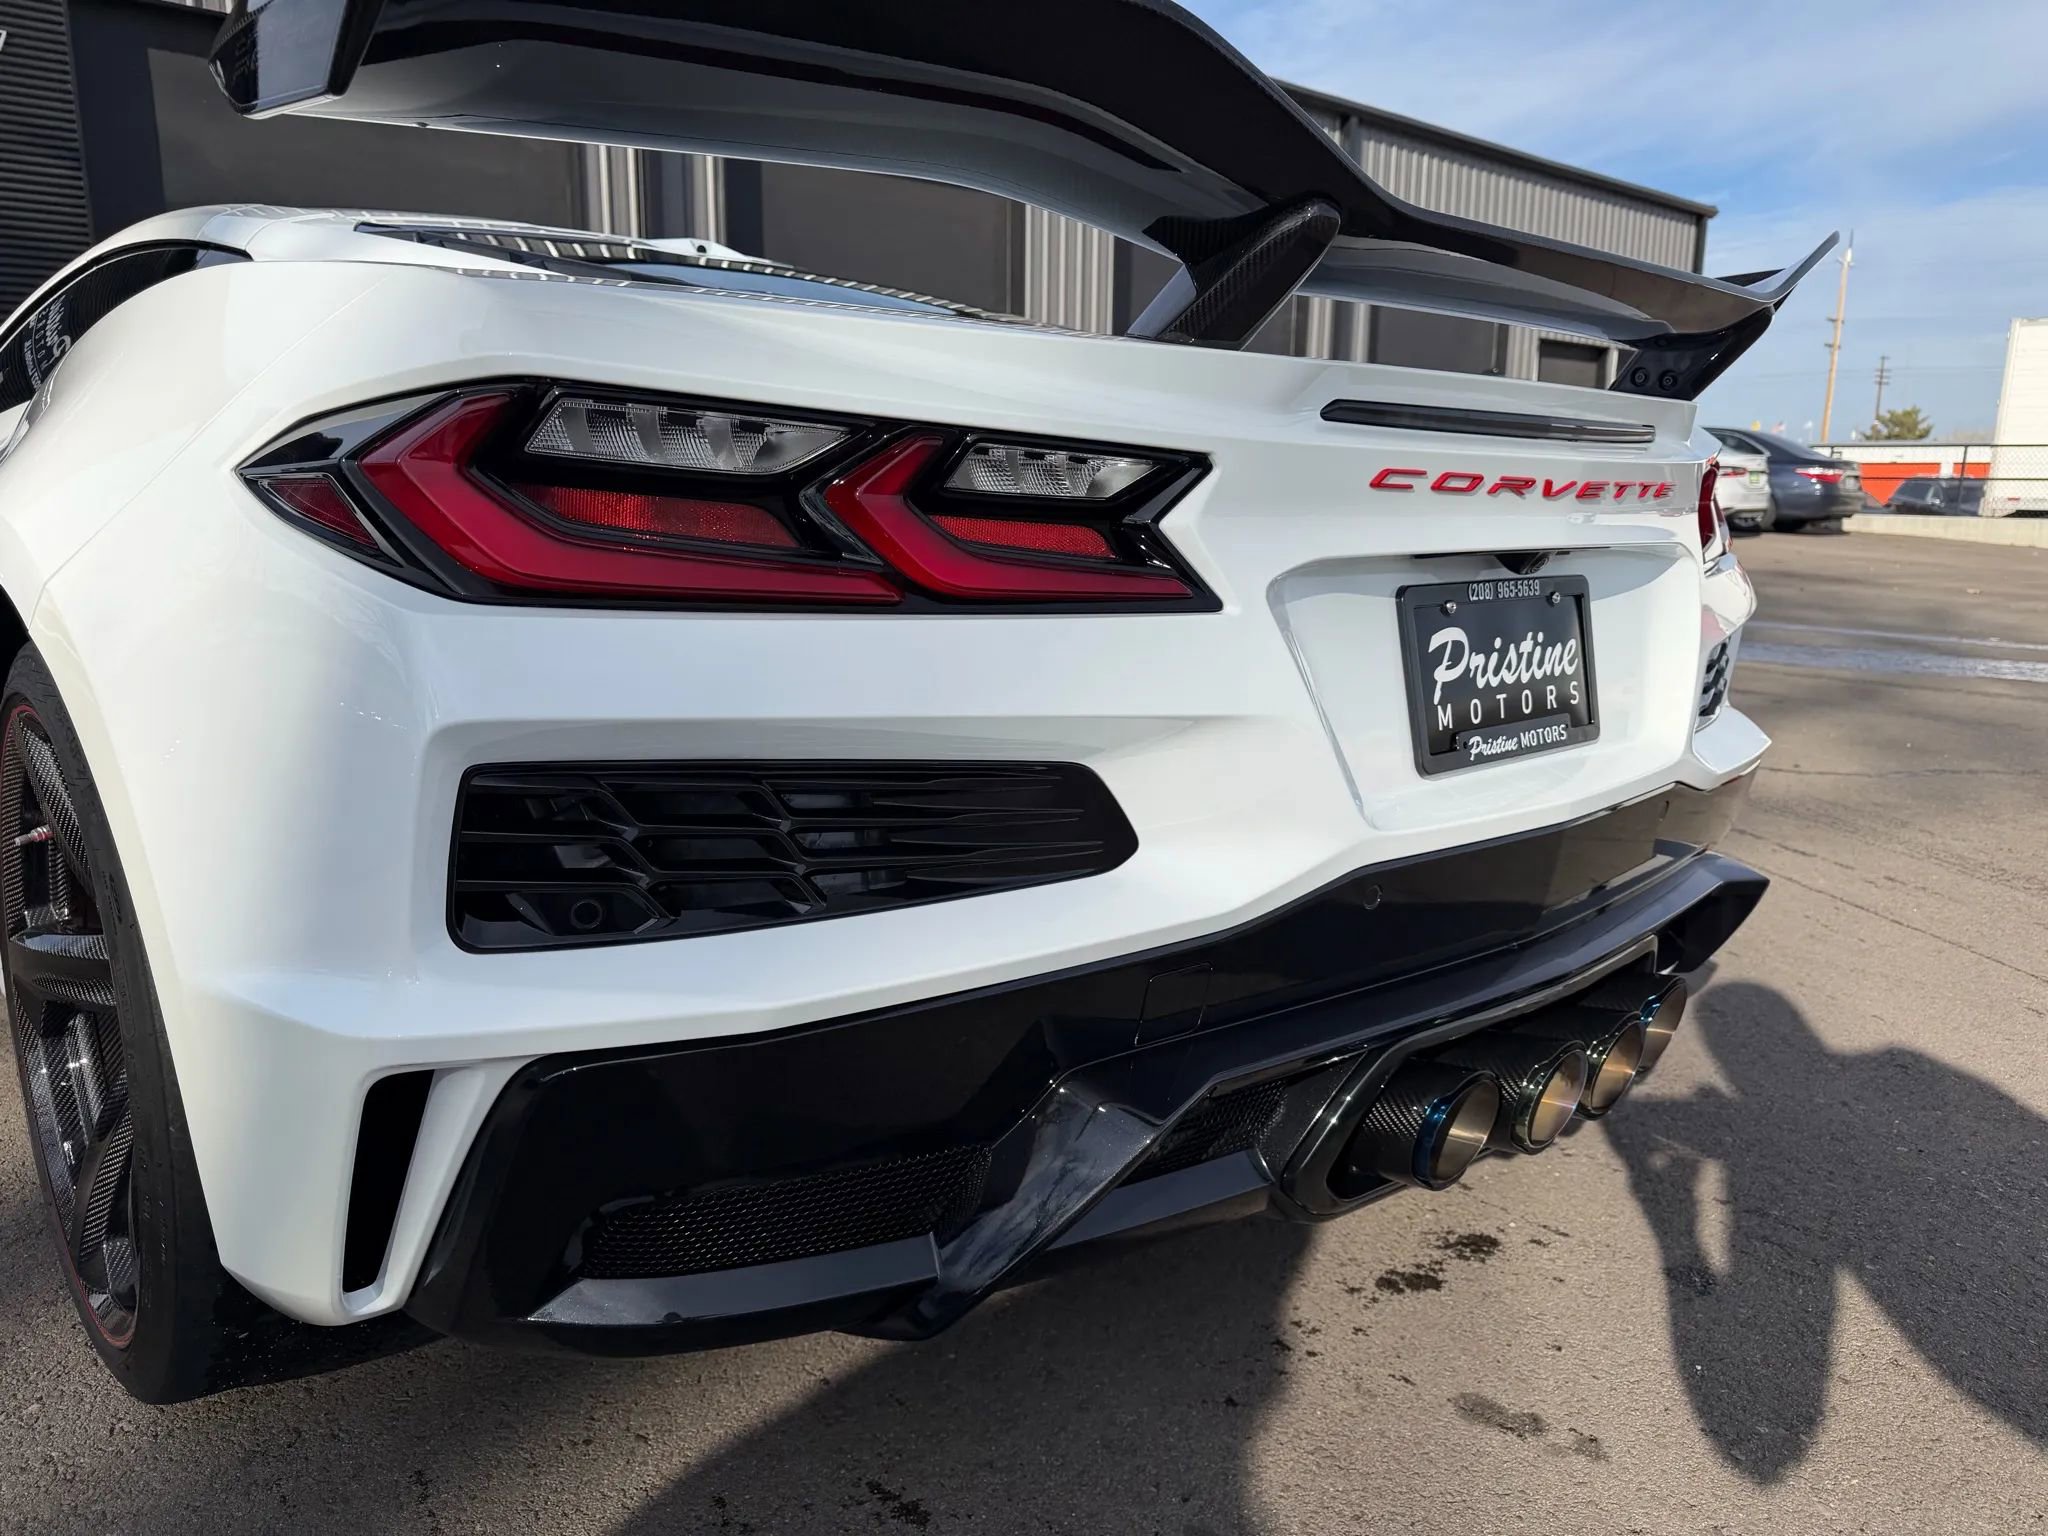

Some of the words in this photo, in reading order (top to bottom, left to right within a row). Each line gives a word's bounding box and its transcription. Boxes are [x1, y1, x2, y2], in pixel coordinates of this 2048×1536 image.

[1369, 468, 1676, 500] CORVETTE
[1468, 582, 1494, 602] (208)
[1497, 579, 1540, 599] 965-5639
[1428, 626, 1578, 705] Pristine
[1437, 681, 1580, 731] MOTORS
[1468, 735, 1518, 761] Pristine
[1520, 724, 1568, 749] MOTORS
